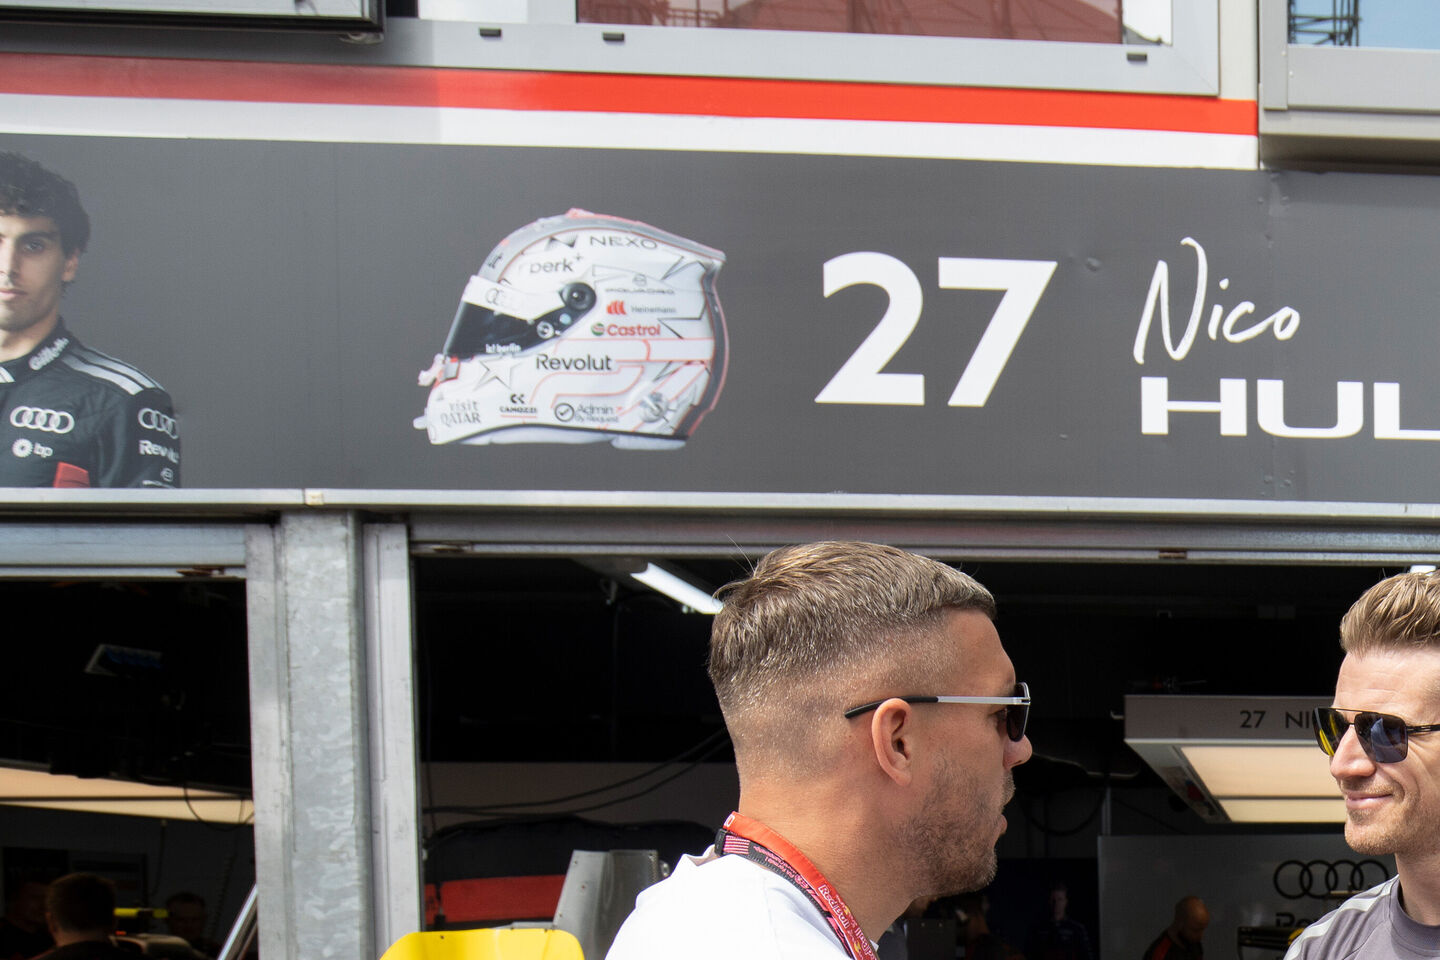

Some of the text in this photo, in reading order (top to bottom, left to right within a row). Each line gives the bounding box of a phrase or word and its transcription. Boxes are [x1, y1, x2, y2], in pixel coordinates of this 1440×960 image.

[606, 323, 661, 336] Castrol
[814, 236, 1300, 407] 27 Nico
[536, 353, 612, 371] Revolut
[1240, 710, 1310, 728] 27 NI
